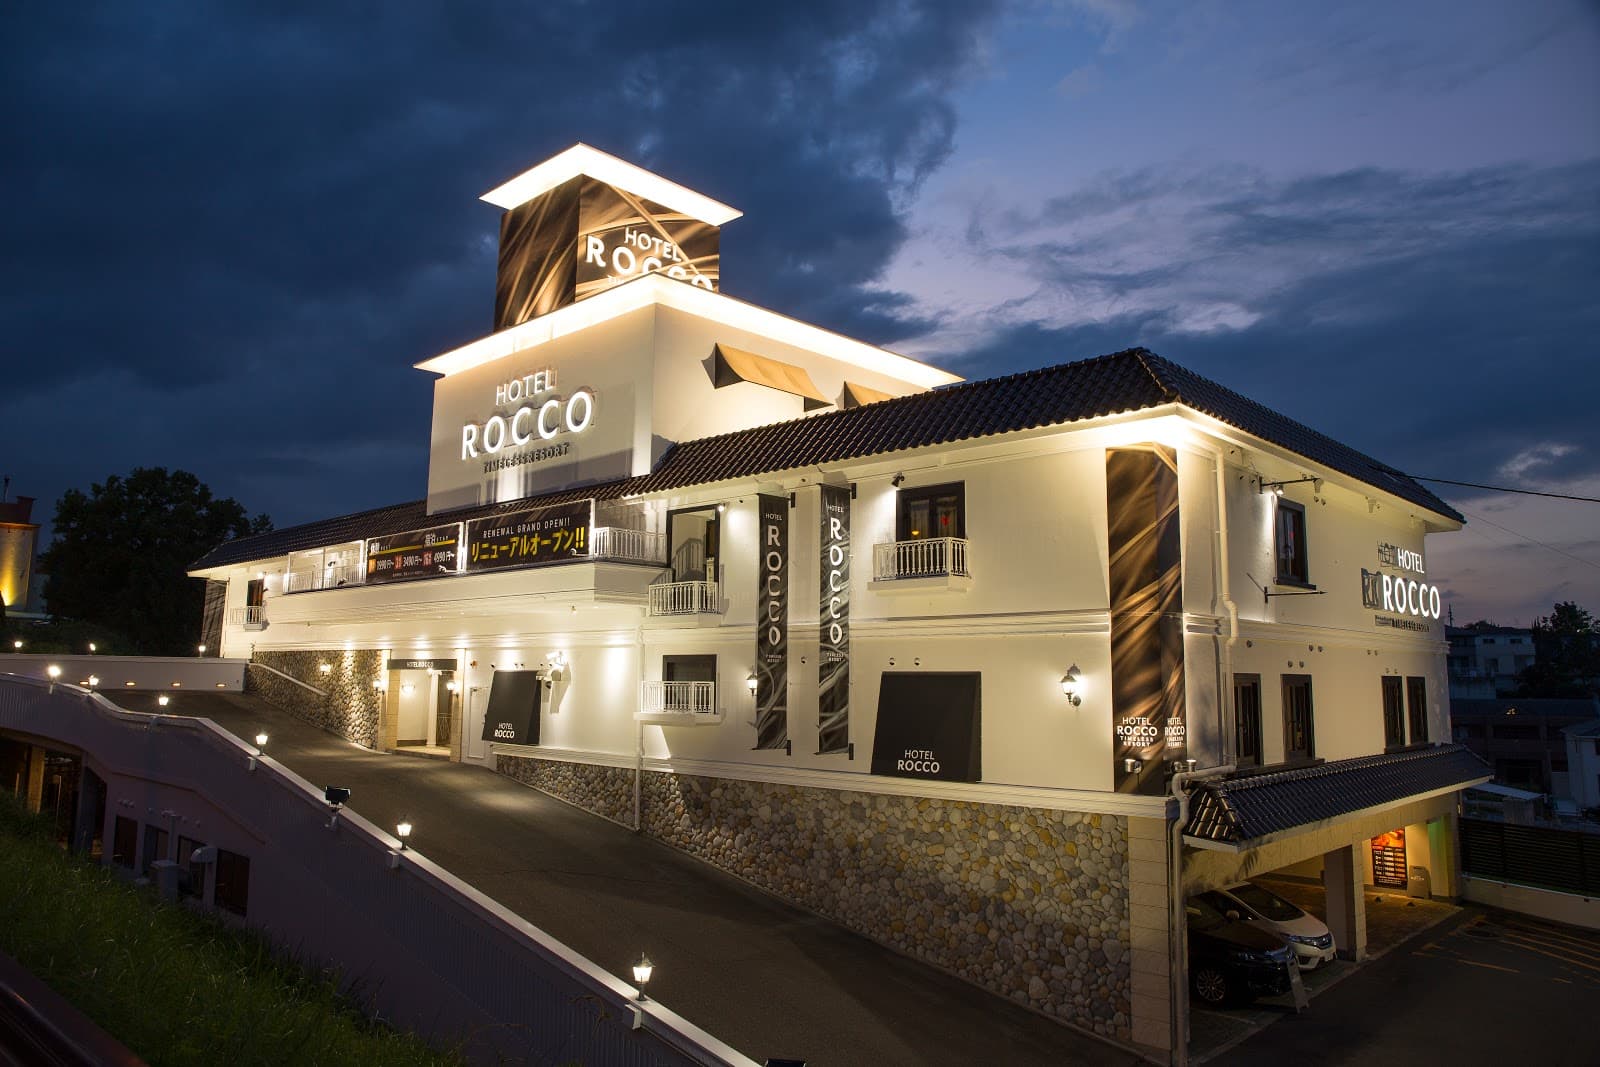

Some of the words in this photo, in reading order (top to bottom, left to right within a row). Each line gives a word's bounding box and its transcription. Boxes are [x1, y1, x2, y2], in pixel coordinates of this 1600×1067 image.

[624, 226, 682, 262] HOTEL
[496, 370, 555, 406] HOTEL
[461, 391, 592, 460] ROCCO
[765, 512, 782, 521] HOTEL
[827, 504, 844, 513] HOTEL
[483, 526, 514, 539] RENEWAL
[517, 521, 541, 533] GRAND
[471, 527, 585, 563] リニューアルオープン!!
[1397, 548, 1424, 574] HOTEL
[766, 525, 782, 646] ROCCO
[829, 517, 844, 644] ROCCO
[1382, 574, 1440, 619] ROCCO
[1122, 717, 1152, 726] HOTEL
[494, 729, 515, 739] ROCCO
[1116, 725, 1158, 737] ROCCO
[1164, 725, 1186, 737] ROCCO
[904, 749, 935, 761] HOTEL
[897, 759, 941, 774] ROCCO
